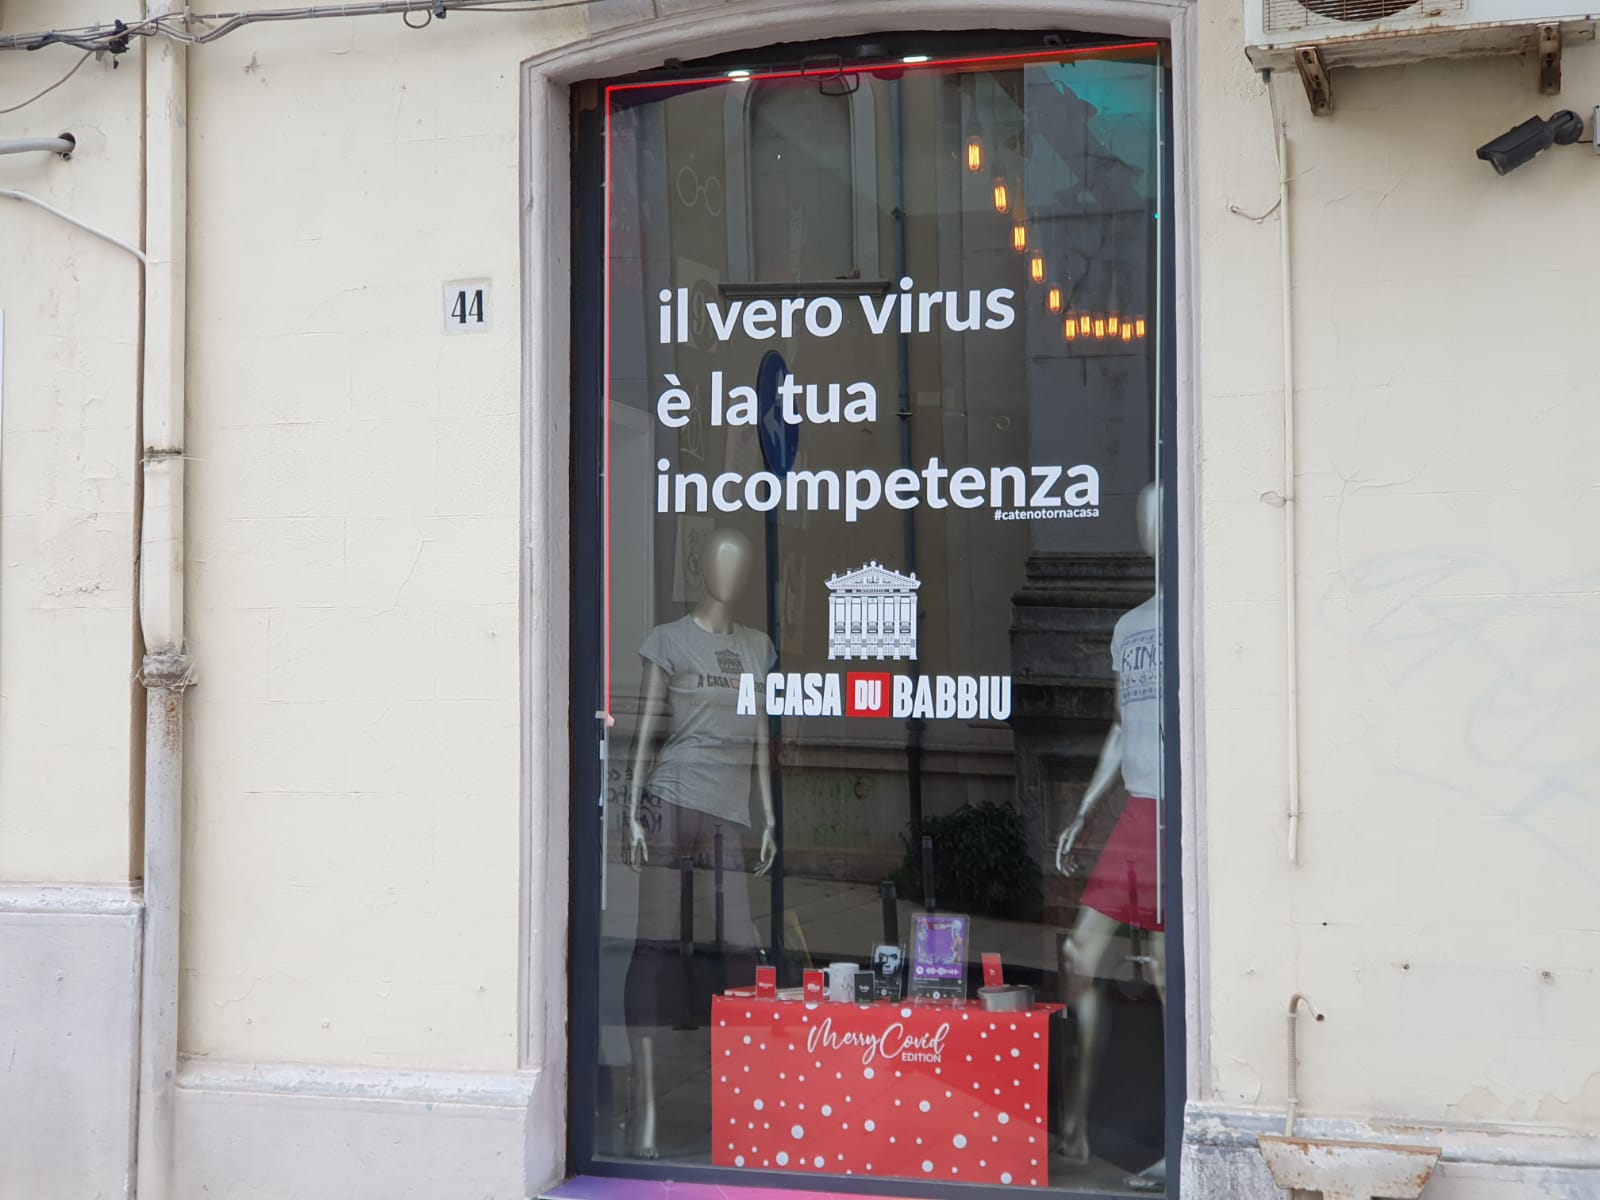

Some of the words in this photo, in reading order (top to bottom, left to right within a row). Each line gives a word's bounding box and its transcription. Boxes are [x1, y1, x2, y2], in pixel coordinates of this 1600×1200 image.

[451, 289, 484, 324] 44
[659, 287, 689, 343] il
[706, 294, 843, 341] vero
[859, 276, 1015, 335] virus
[657, 373, 691, 427] è
[711, 371, 758, 426] la
[777, 374, 877, 424] tua
[657, 457, 1100, 522] incompetenza
[994, 508, 1099, 521] #catenotornacasa
[736, 672, 757, 715] A
[765, 672, 842, 716] CASA
[854, 681, 882, 711] DU
[892, 674, 1012, 721] BABBIU
[901, 1052, 941, 1063] EDITION
